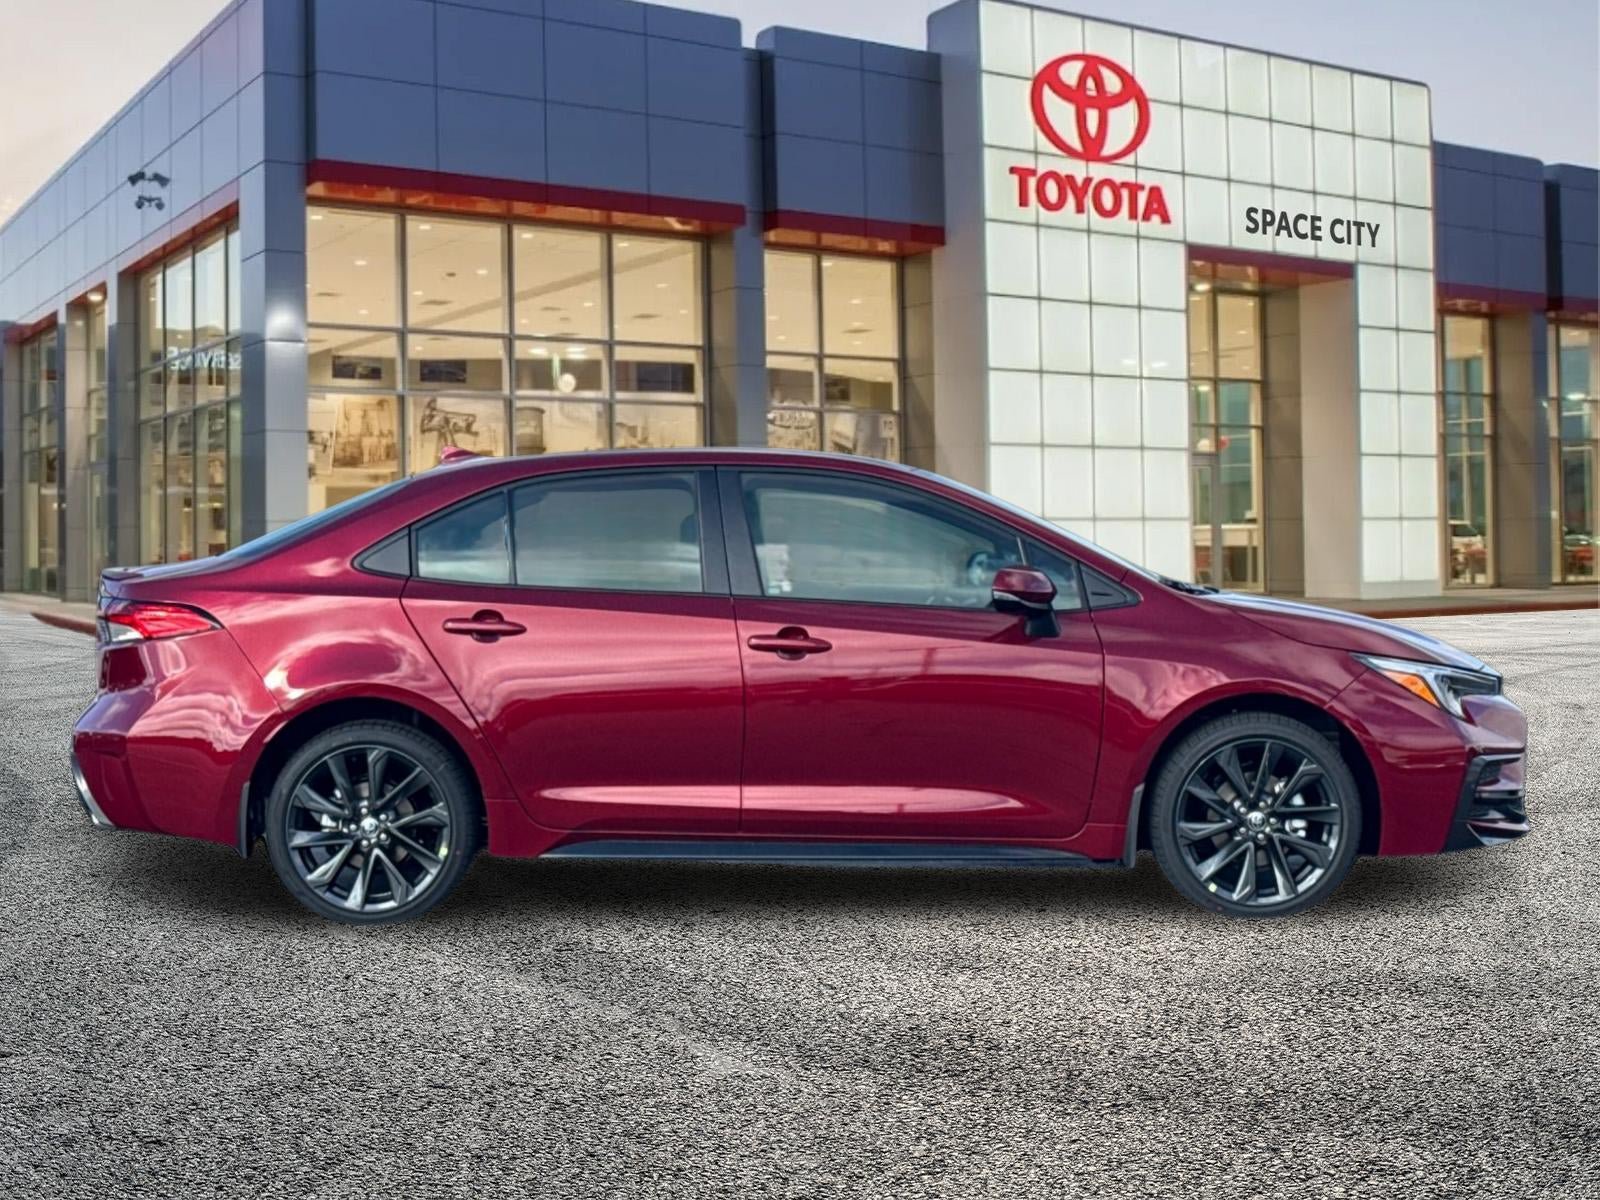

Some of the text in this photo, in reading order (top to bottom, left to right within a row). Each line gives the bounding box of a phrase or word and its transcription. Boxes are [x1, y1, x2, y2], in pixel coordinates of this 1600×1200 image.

[1009, 166, 1171, 225] TOYOTA
[1245, 206, 1381, 248] SPACE CITY
